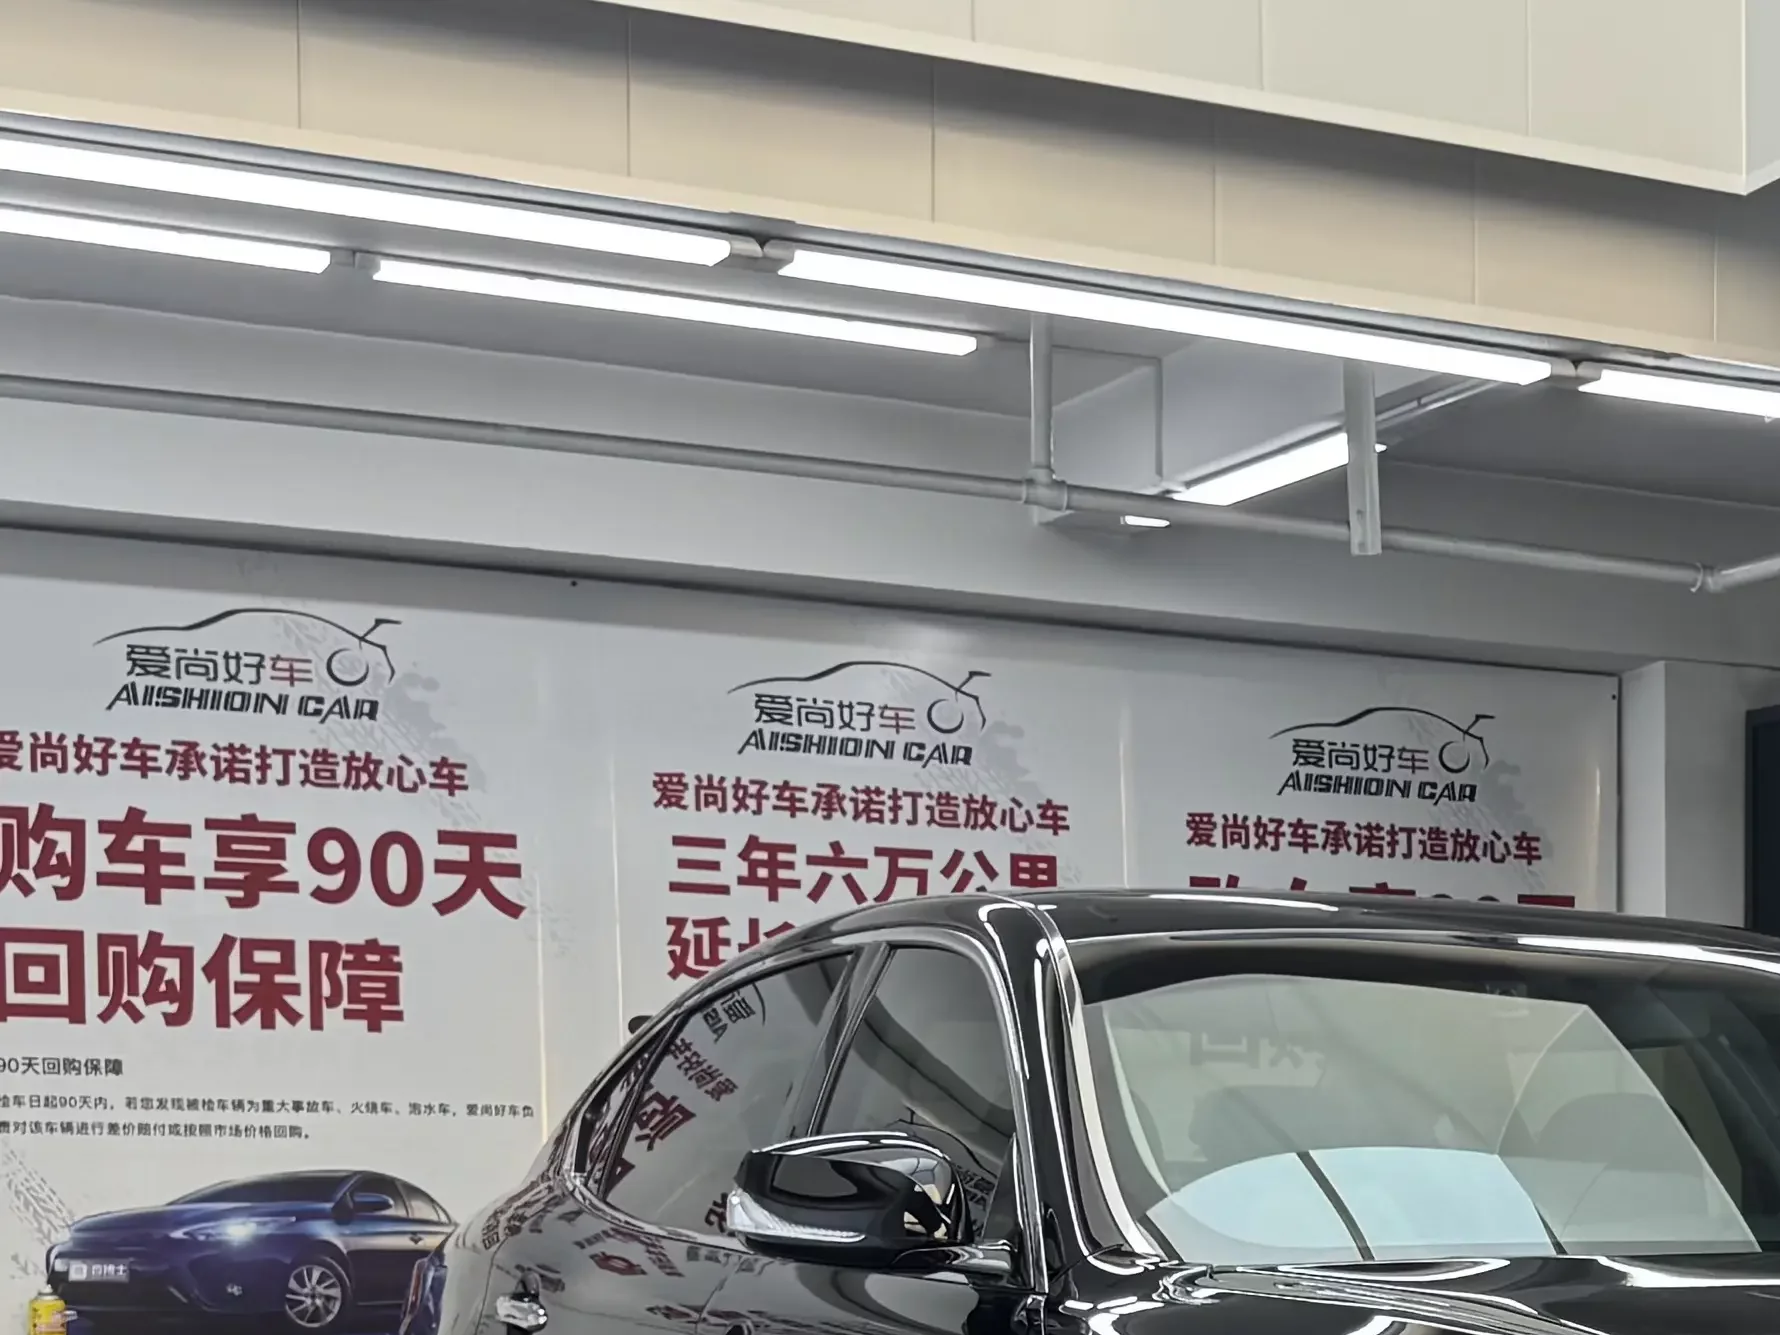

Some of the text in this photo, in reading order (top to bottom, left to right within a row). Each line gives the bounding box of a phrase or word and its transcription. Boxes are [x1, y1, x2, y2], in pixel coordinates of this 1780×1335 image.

[126, 644, 313, 687] 爱尚好车
[106, 682, 379, 724] AISHION CAR
[754, 693, 915, 734] 爱尚好车
[738, 729, 973, 768] AISHION CAR
[1292, 738, 1429, 774] 爱尚好车
[652, 772, 1070, 836] 爱尚好车承诺打造放心车
[1277, 770, 1478, 806] AISHION CAR
[1186, 812, 1542, 866] 爱尚好车承诺打造放心车
[0, 803, 526, 920] 购车享90天
[668, 834, 1058, 905] 三年六万公里
[0, 927, 404, 1033] 回购保障
